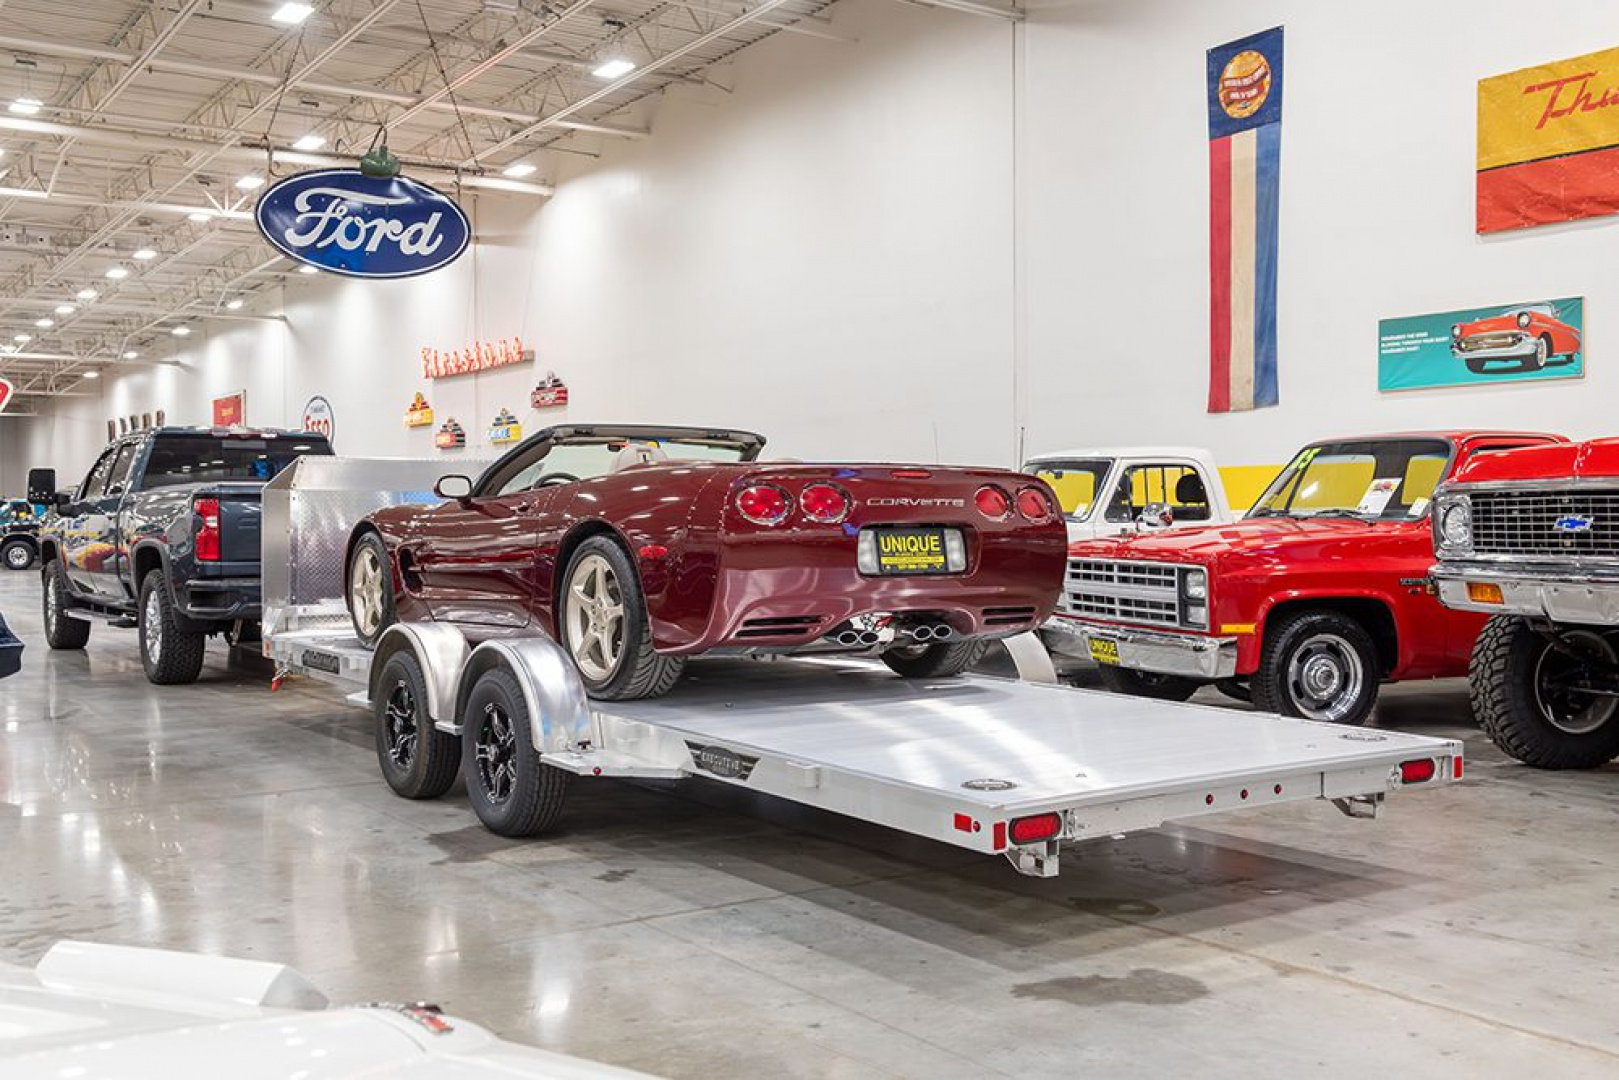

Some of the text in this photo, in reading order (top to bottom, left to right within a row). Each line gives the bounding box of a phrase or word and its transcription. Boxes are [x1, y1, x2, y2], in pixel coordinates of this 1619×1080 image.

[284, 187, 443, 255] Ford
[867, 498, 964, 507] CORVETTE
[880, 535, 941, 553] UNIQUE
